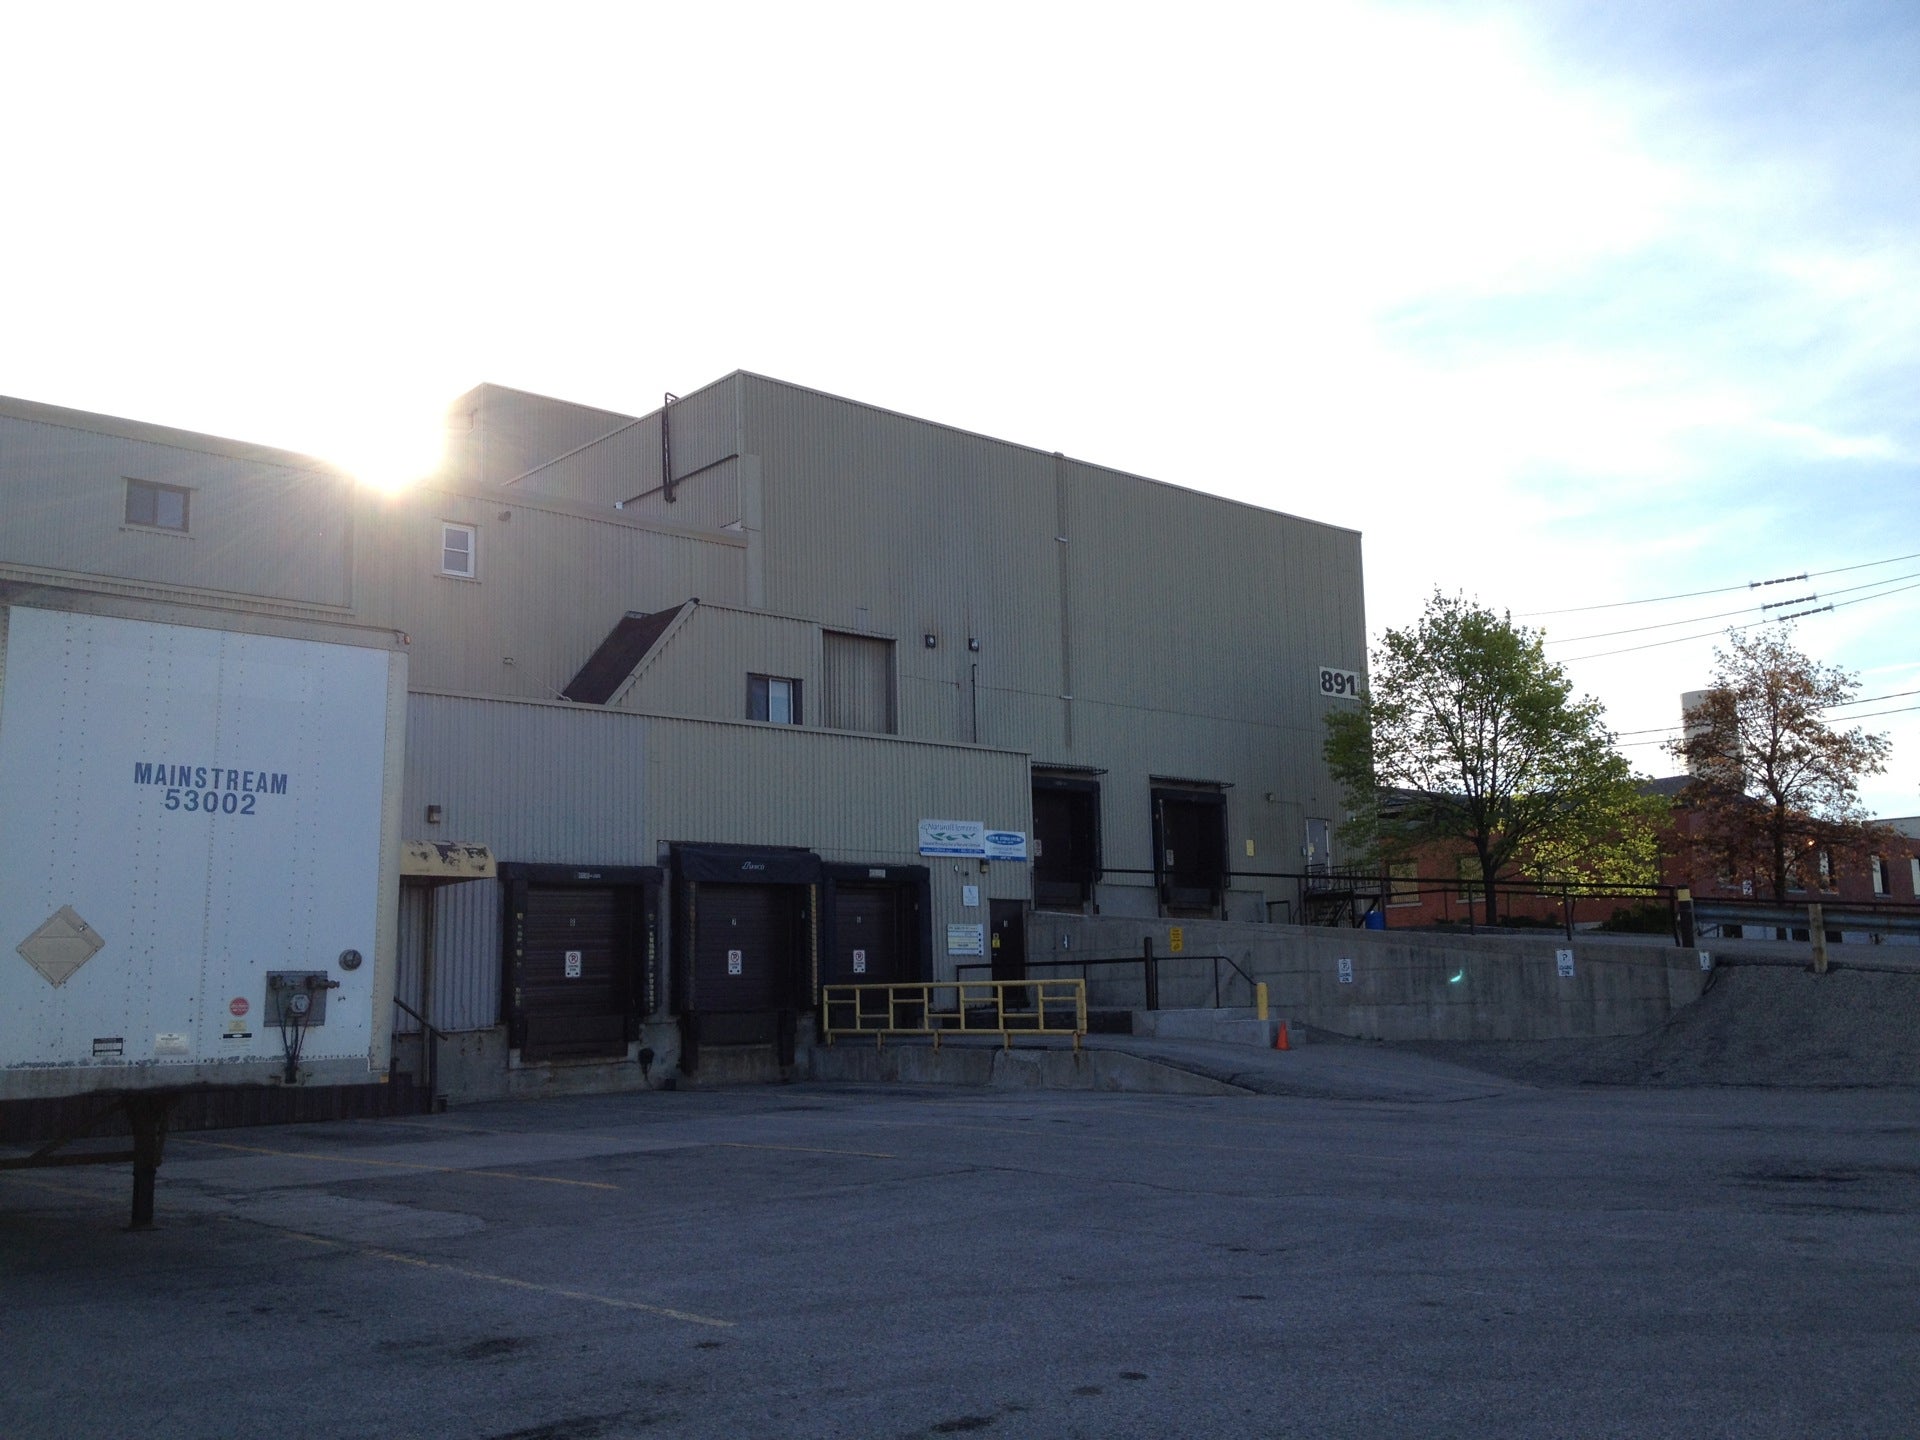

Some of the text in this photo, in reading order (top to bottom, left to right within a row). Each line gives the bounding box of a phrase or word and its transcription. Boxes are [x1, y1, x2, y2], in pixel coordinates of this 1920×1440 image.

[1321, 670, 1355, 695] 891
[134, 762, 288, 795] MAINSTREAM
[164, 788, 256, 815] 53002
